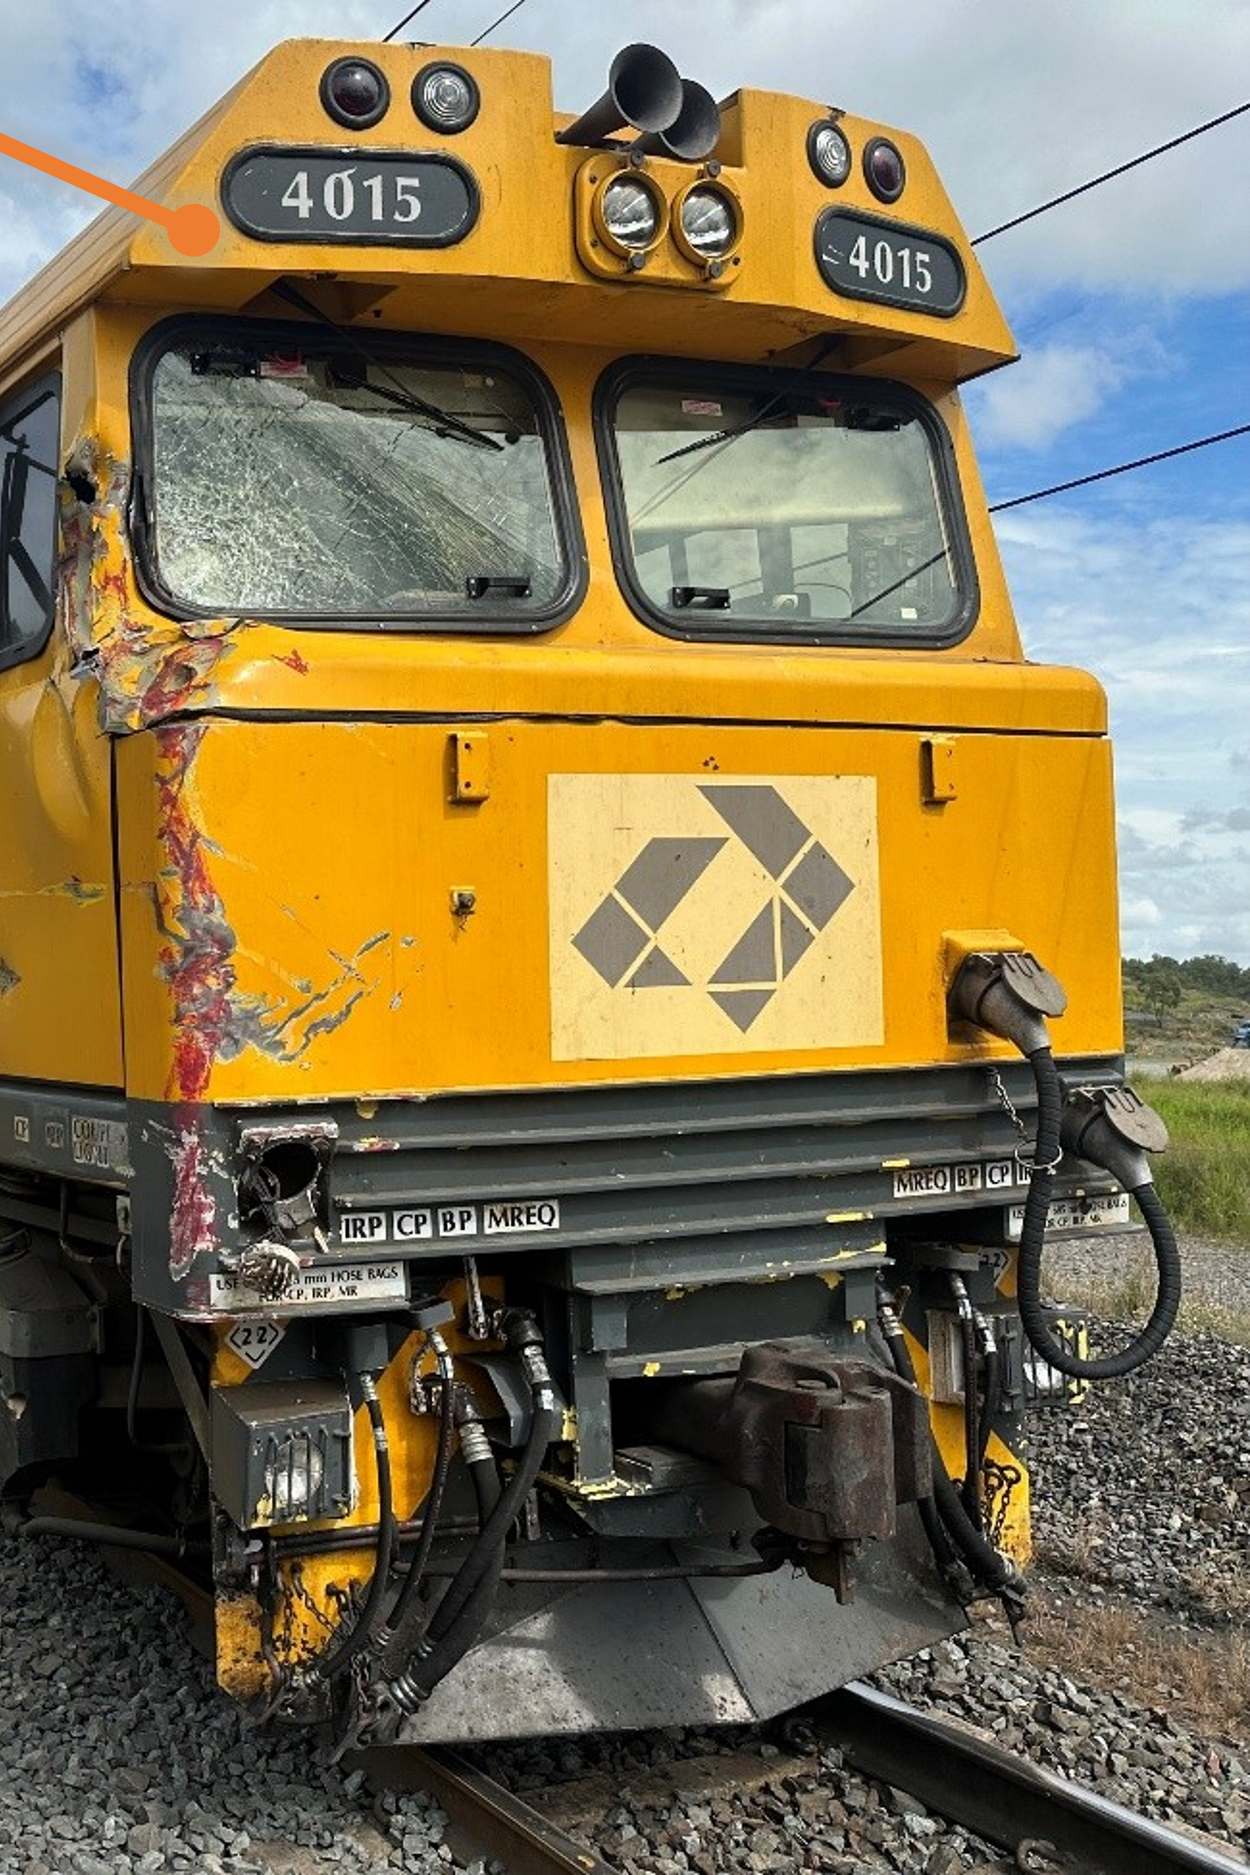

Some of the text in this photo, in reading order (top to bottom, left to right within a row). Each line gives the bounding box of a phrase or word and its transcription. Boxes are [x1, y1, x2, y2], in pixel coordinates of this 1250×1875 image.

[281, 168, 422, 223] 4015
[849, 235, 932, 293] 4015
[897, 1169, 948, 1193] MREQ
[957, 1167, 979, 1187] BP
[988, 1165, 1009, 1185] CP
[344, 1204, 556, 1239] IRP CP BP MREQ
[304, 1274, 327, 1285] mm
[331, 1270, 363, 1283] HOSE
[368, 1266, 398, 1280] BAGS
